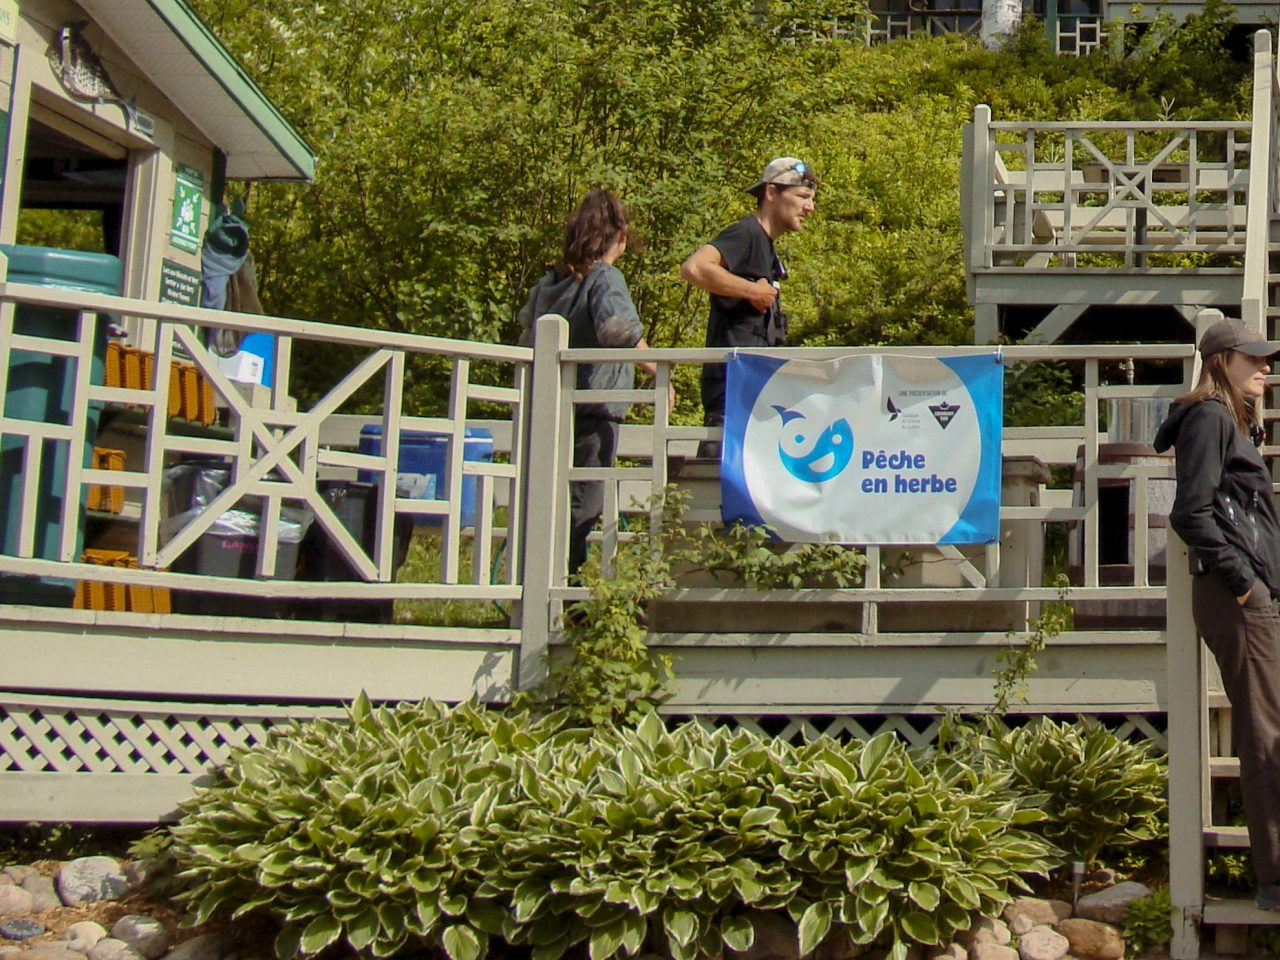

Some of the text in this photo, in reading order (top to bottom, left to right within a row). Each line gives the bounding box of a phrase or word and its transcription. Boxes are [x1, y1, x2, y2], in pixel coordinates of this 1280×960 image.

[862, 449, 926, 470] Pêche
[861, 473, 958, 493] en herbe
